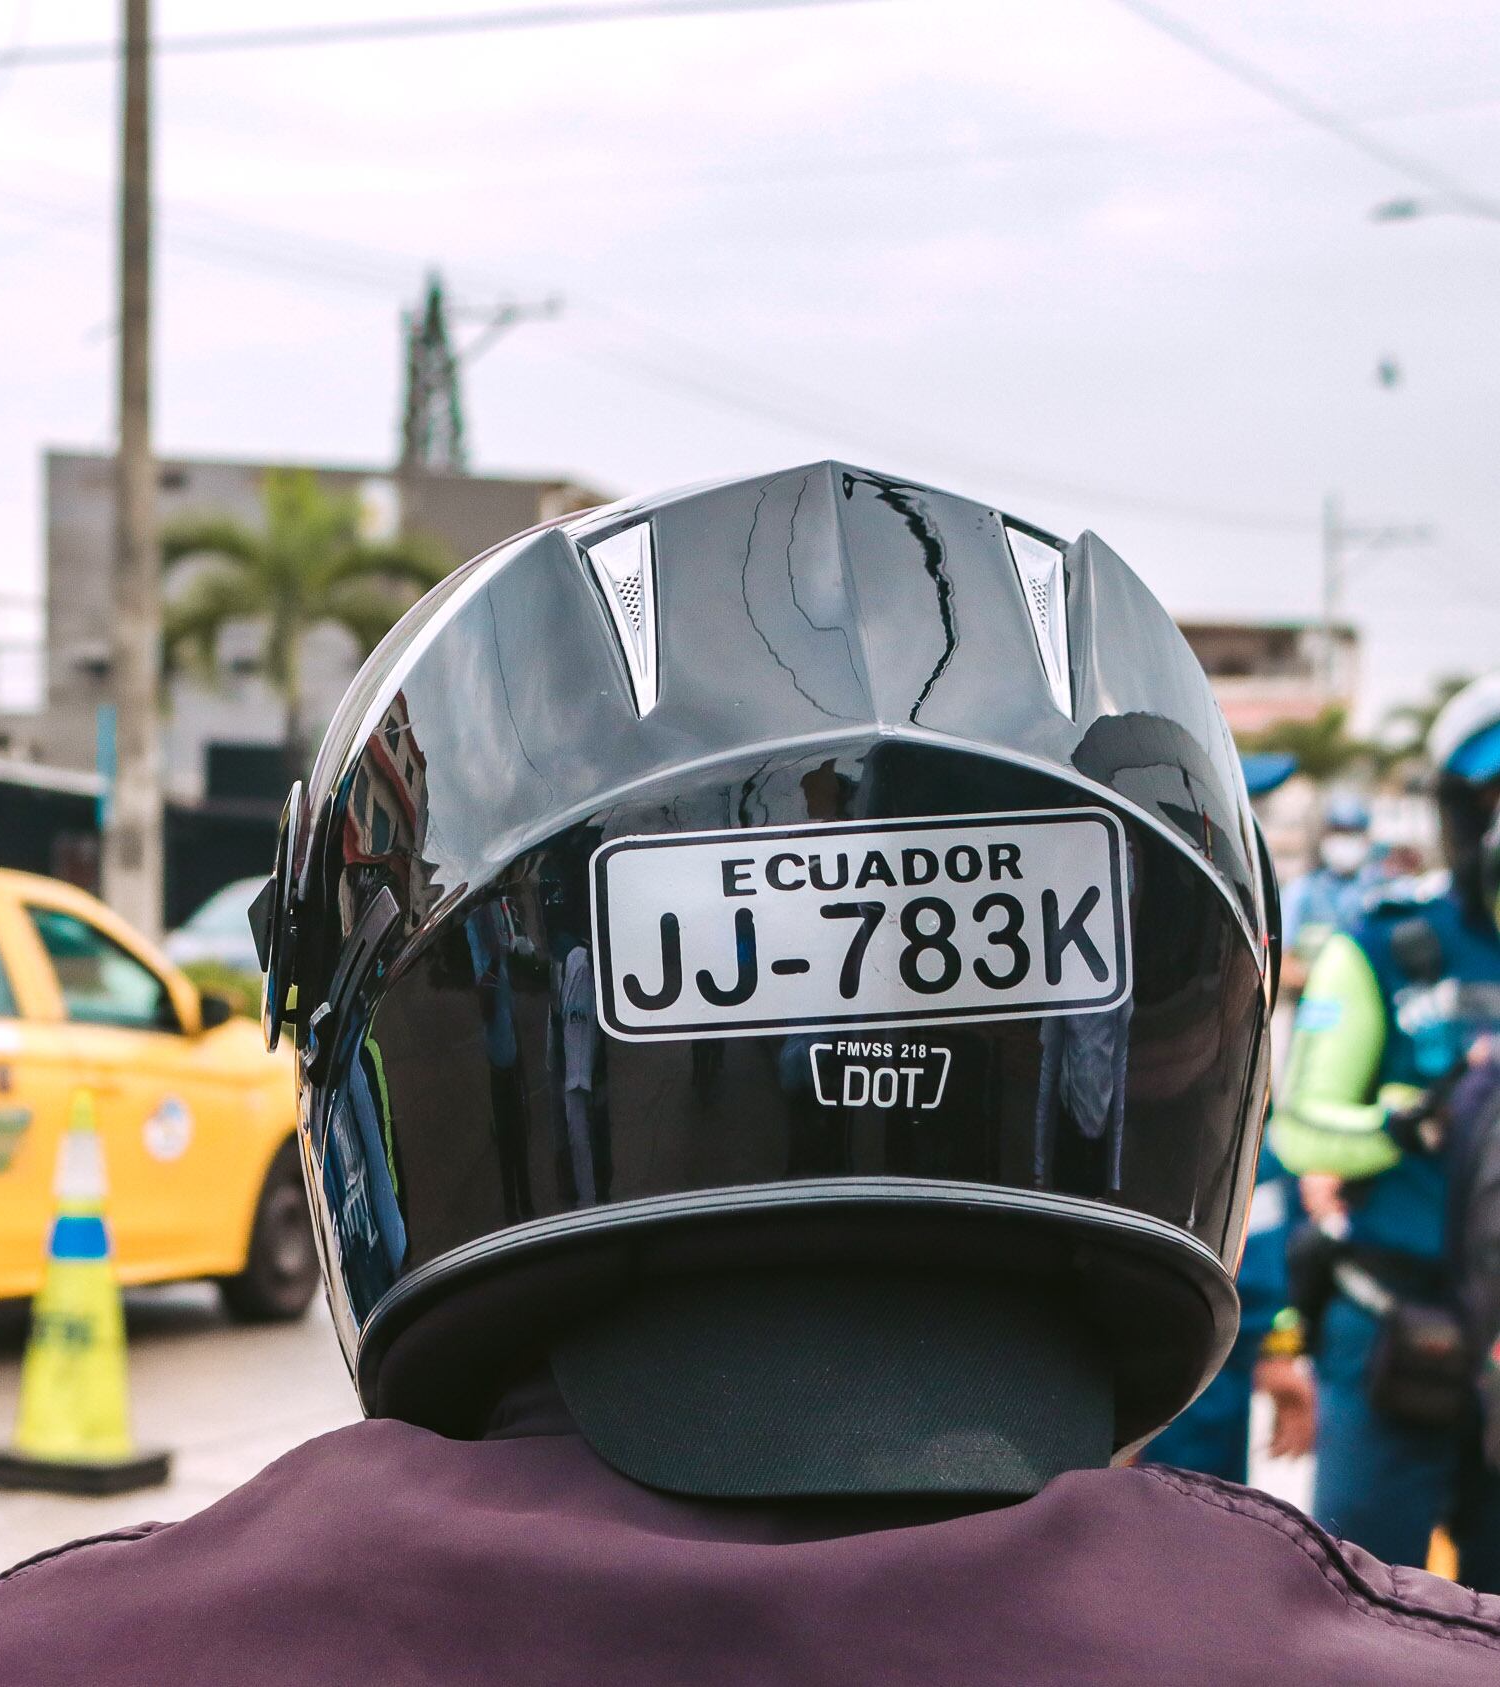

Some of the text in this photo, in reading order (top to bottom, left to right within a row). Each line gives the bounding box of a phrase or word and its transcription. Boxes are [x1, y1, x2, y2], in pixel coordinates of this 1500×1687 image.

[721, 843, 1024, 897] ECUADOR
[622, 885, 1109, 1010] JJ-783K
[836, 1040, 927, 1059] FMVSS 218
[842, 1065, 924, 1108] DOT
